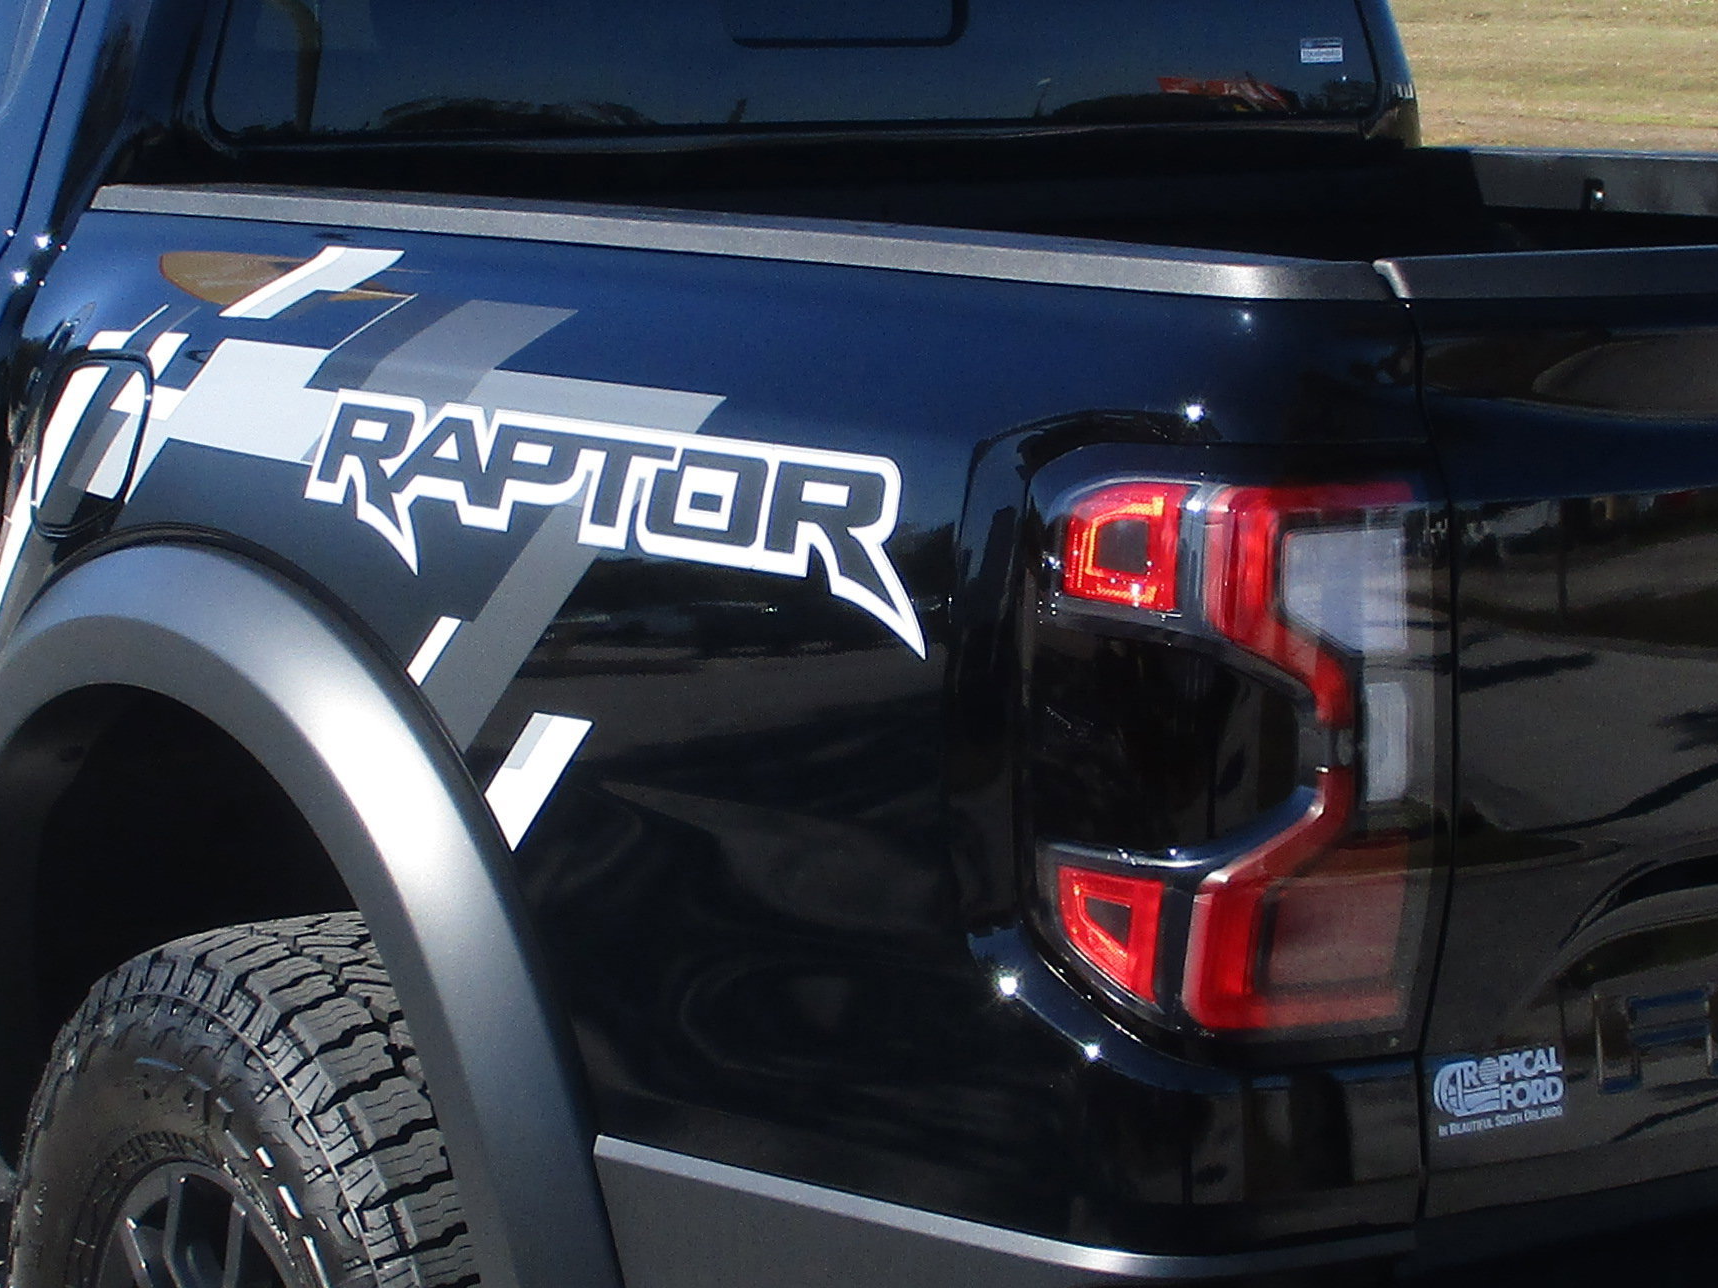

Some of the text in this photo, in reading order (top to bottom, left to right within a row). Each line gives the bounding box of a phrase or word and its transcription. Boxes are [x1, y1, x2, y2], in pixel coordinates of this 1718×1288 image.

[304, 388, 926, 660] RAPTOR
[1433, 1046, 1563, 1112] TROPICAL
[1500, 1076, 1564, 1111] FORD
